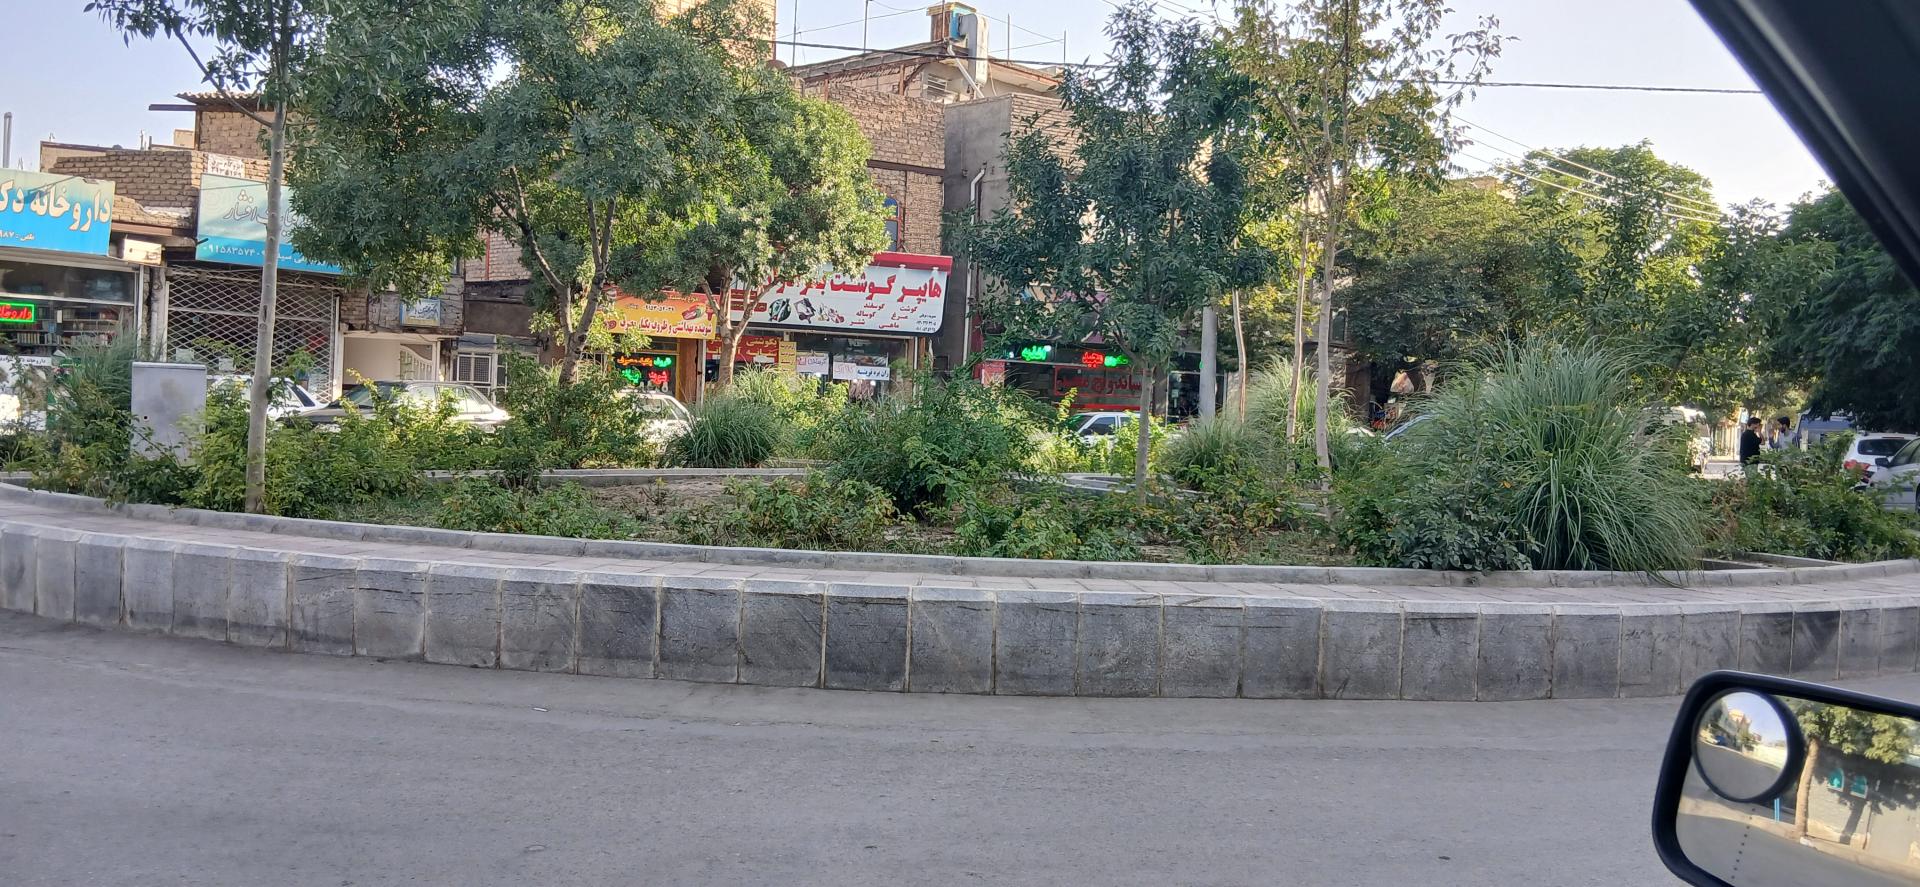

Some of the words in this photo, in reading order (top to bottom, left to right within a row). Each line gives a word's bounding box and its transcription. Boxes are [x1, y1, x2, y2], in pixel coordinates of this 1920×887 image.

[0, 180, 25, 213] دک
[223, 188, 258, 220] افشار
[30, 185, 111, 232] داروخانه
[829, 272, 896, 300] گوشت
[897, 277, 942, 304] هایپر
[0, 304, 32, 319] داروخا
[856, 311, 876, 319] گوساله
[863, 302, 885, 311] گوسفند
[891, 312, 908, 321] مرغ
[900, 306, 917, 314] گوشت
